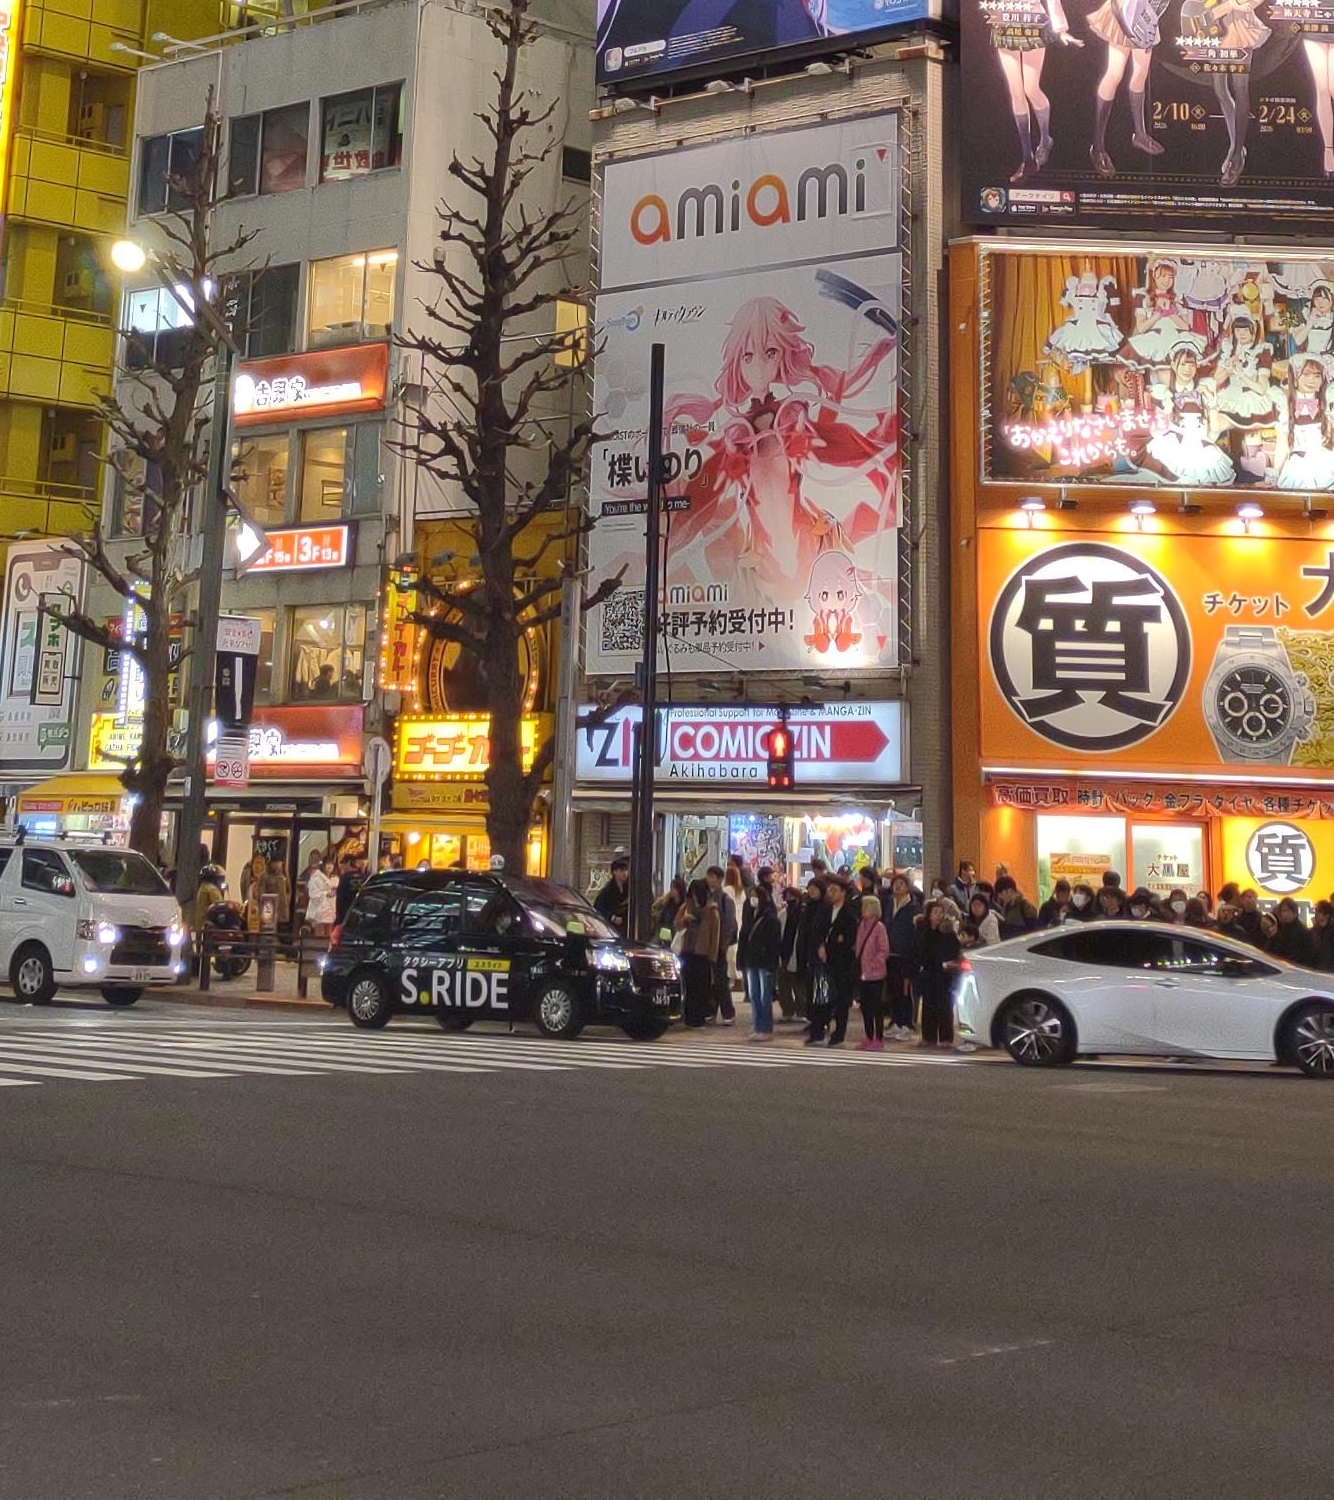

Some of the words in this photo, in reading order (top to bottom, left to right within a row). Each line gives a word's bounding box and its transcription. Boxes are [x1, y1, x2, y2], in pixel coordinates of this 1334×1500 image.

[629, 158, 867, 247] amiami
[298, 535, 321, 563] 3F
[1203, 591, 1290, 617] チケット
[1017, 574, 1174, 725] 質
[669, 763, 758, 778] Akihabara
[995, 784, 1069, 806] 高価買取
[1146, 862, 1191, 879] 大黒屋
[1254, 832, 1308, 887] 質
[401, 956, 465, 970] タクシーアプリ
[400, 968, 510, 1010] S.RIDE
